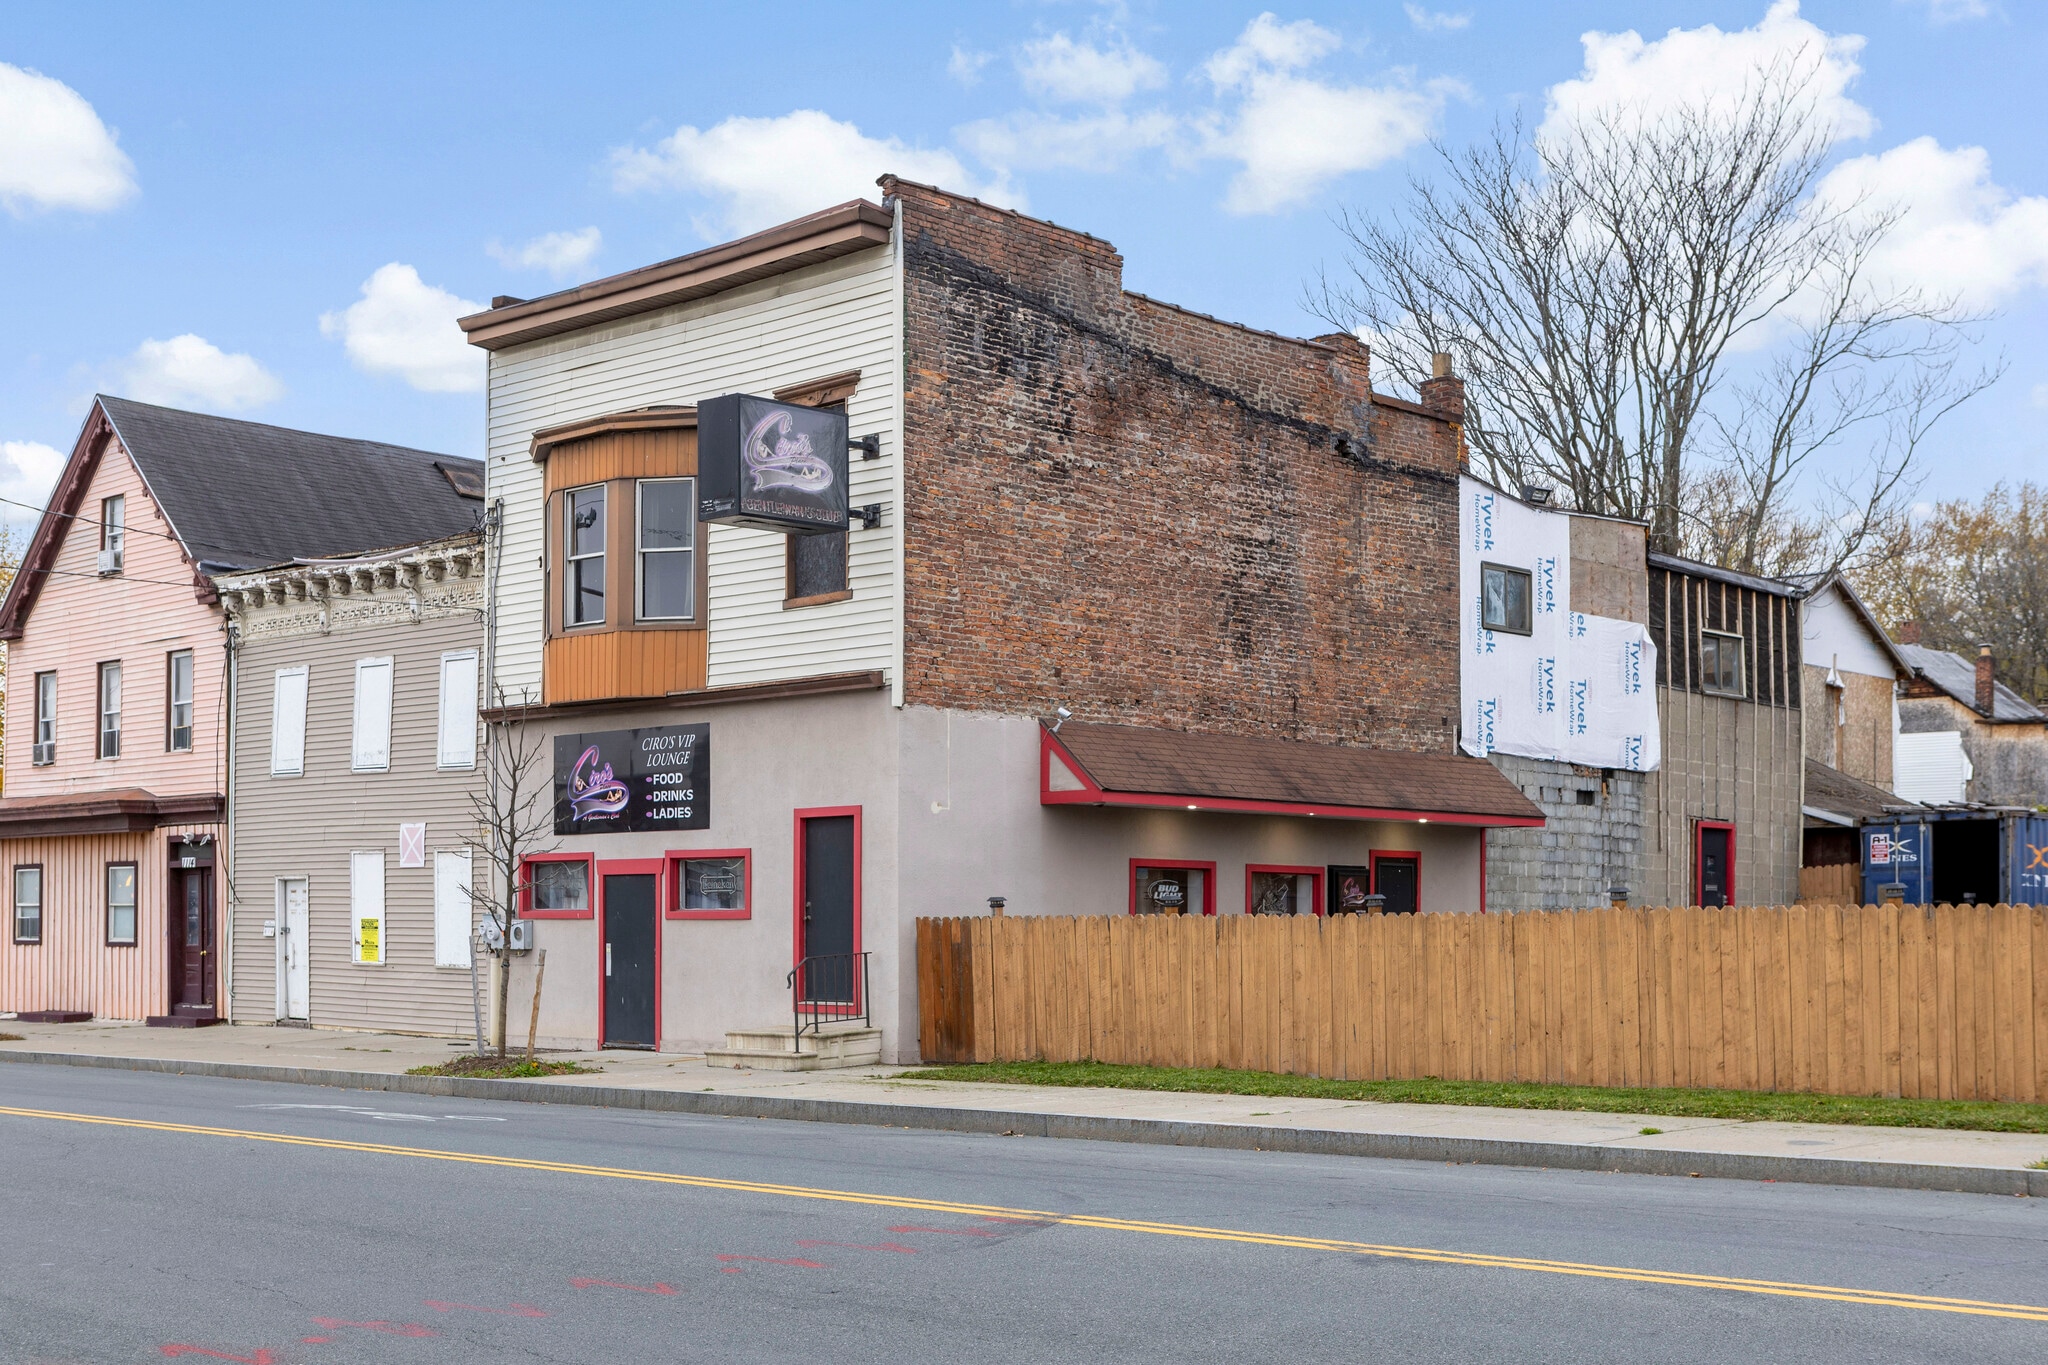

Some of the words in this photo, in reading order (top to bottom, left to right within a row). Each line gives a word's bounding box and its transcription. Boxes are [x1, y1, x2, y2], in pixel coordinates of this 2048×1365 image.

[1481, 493, 1494, 551] Tyvek
[1544, 556, 1556, 613] Tyvek
[1544, 656, 1555, 712] Tyvek
[1630, 640, 1642, 693] Tyvek
[1575, 679, 1586, 735] Tyvek
[642, 735, 676, 751] CIRO'S
[678, 734, 696, 748] VIP
[646, 751, 690, 767] LOUNGE
[1630, 735, 1642, 770] Tyv
[653, 772, 683, 786] FOOD
[653, 789, 694, 802] DRINKS
[653, 806, 692, 820] LADIES
